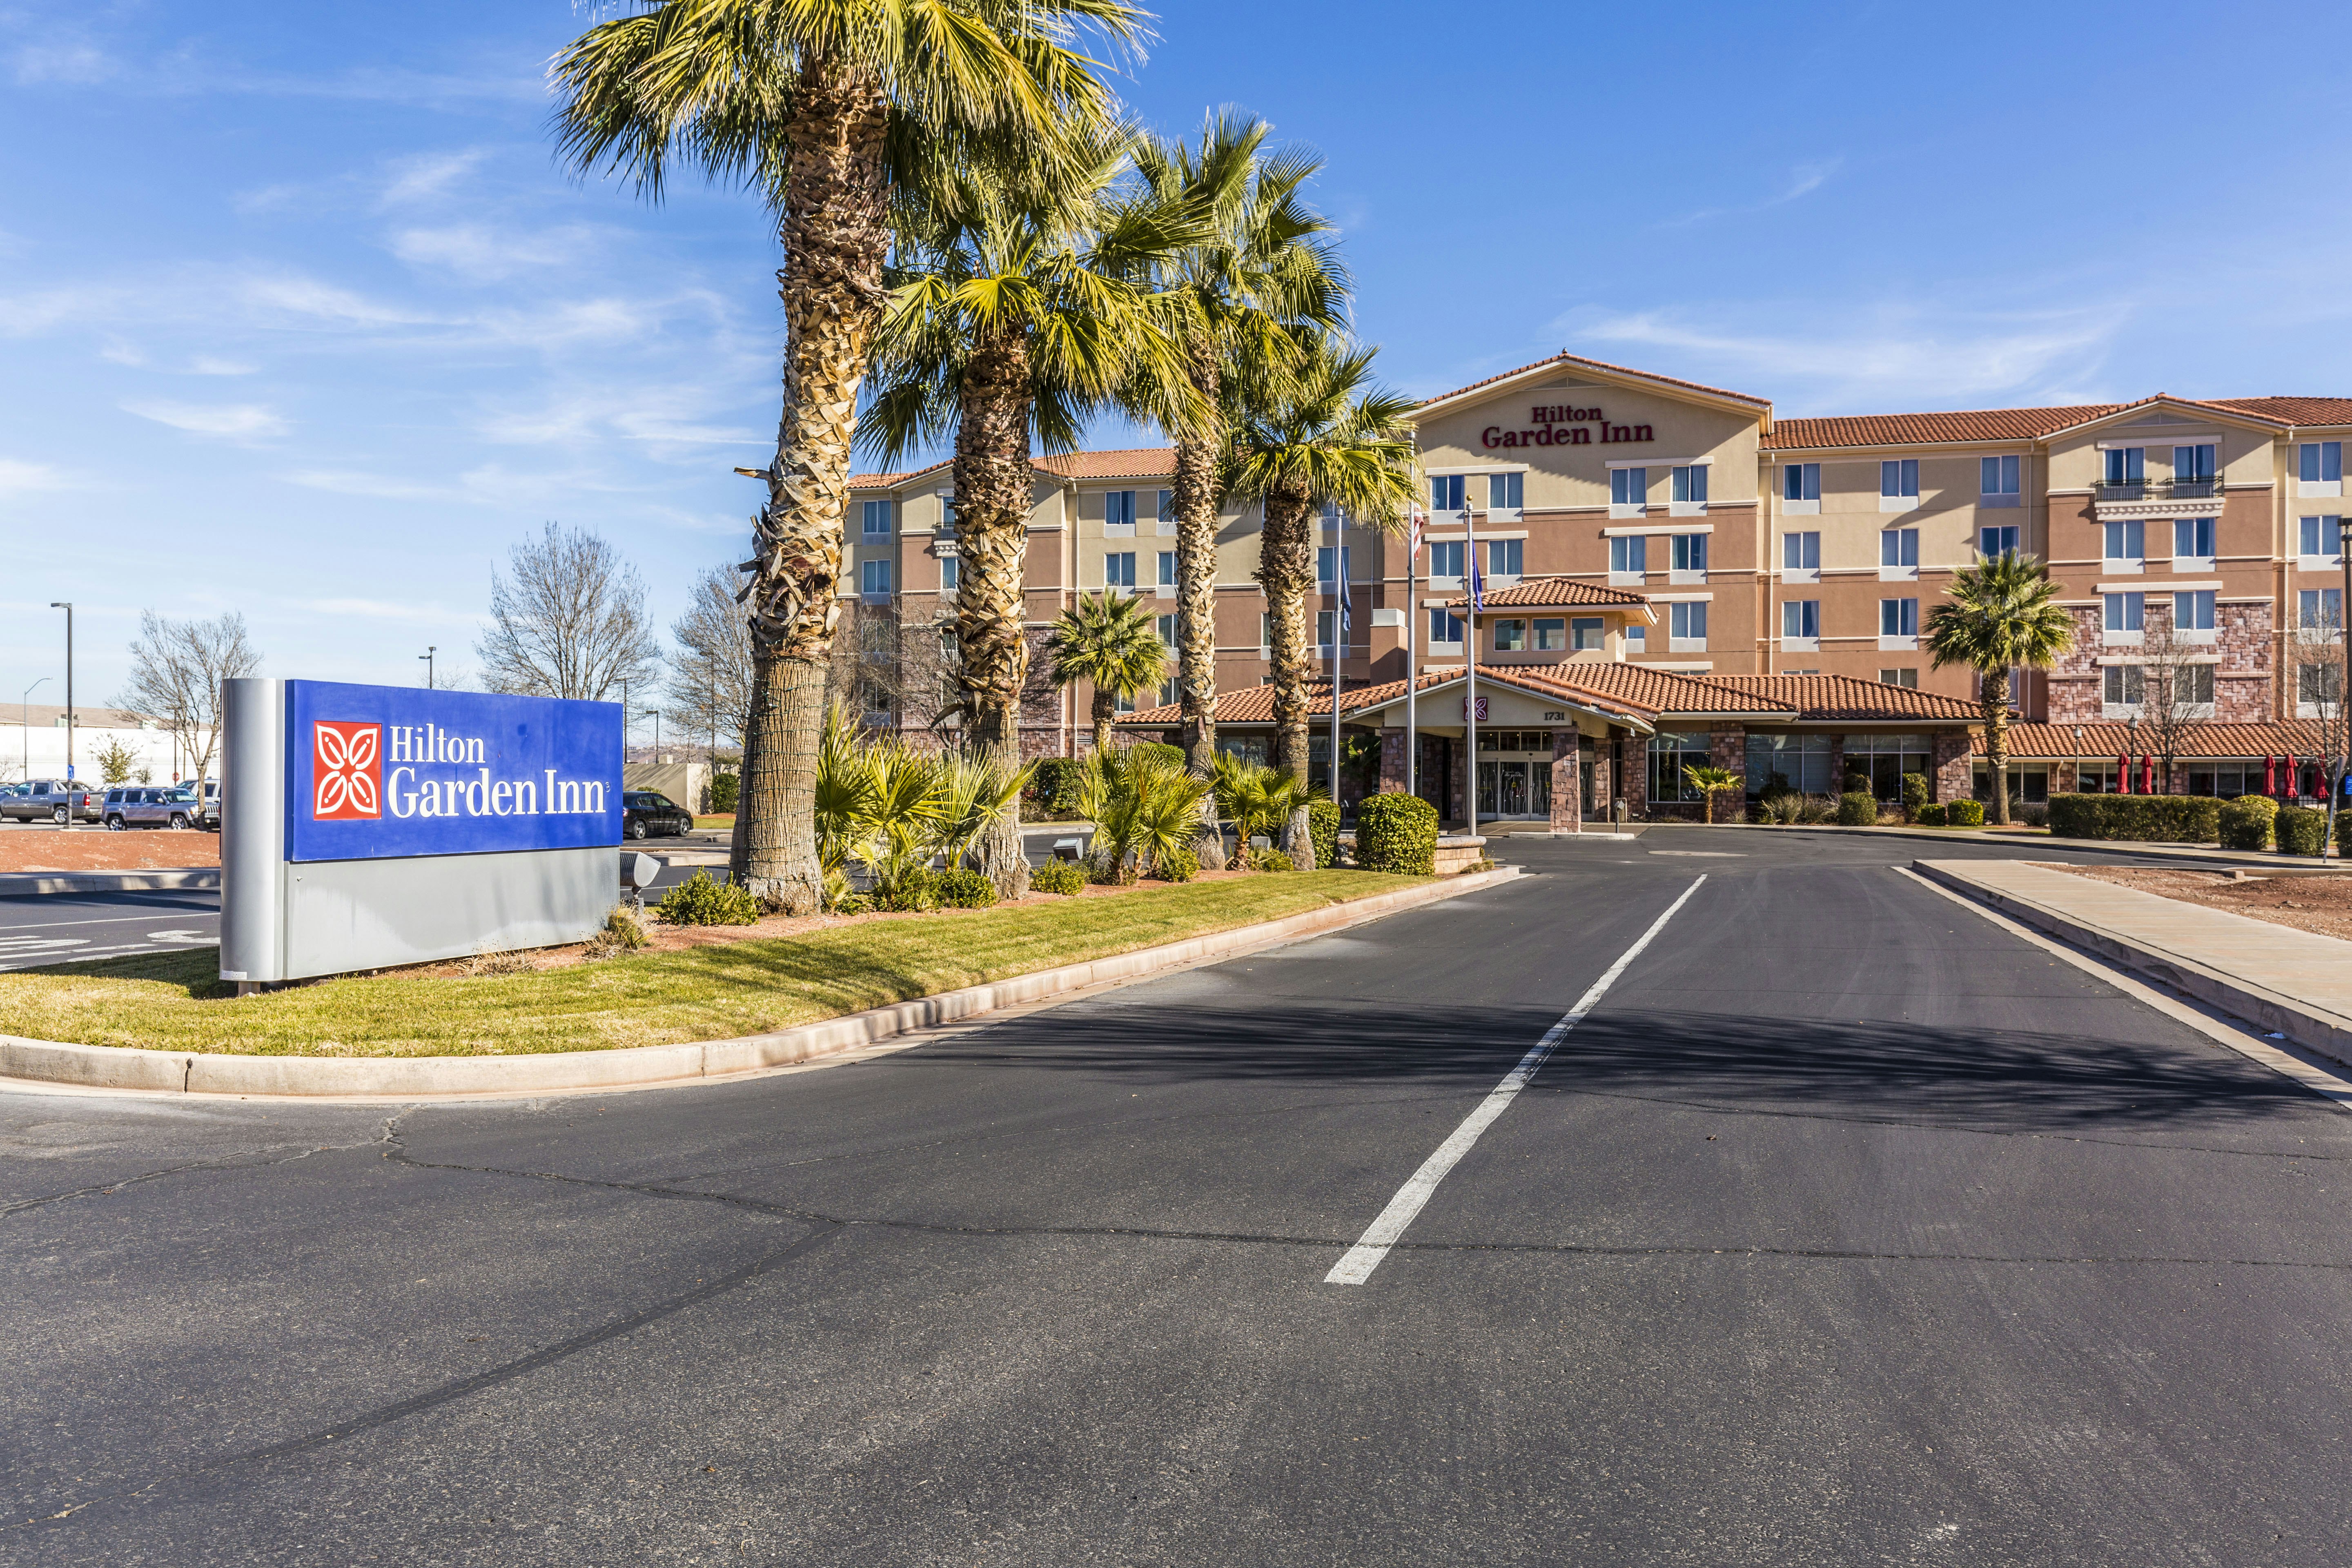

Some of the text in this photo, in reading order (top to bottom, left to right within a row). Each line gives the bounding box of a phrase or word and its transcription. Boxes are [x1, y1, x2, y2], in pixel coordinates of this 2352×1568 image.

[1532, 405, 1603, 423] Hilton
[1482, 421, 1655, 449] Garden Inn
[1544, 712, 1565, 720] 1731
[389, 723, 486, 763] Hilton
[388, 766, 606, 818] Garden Inn
